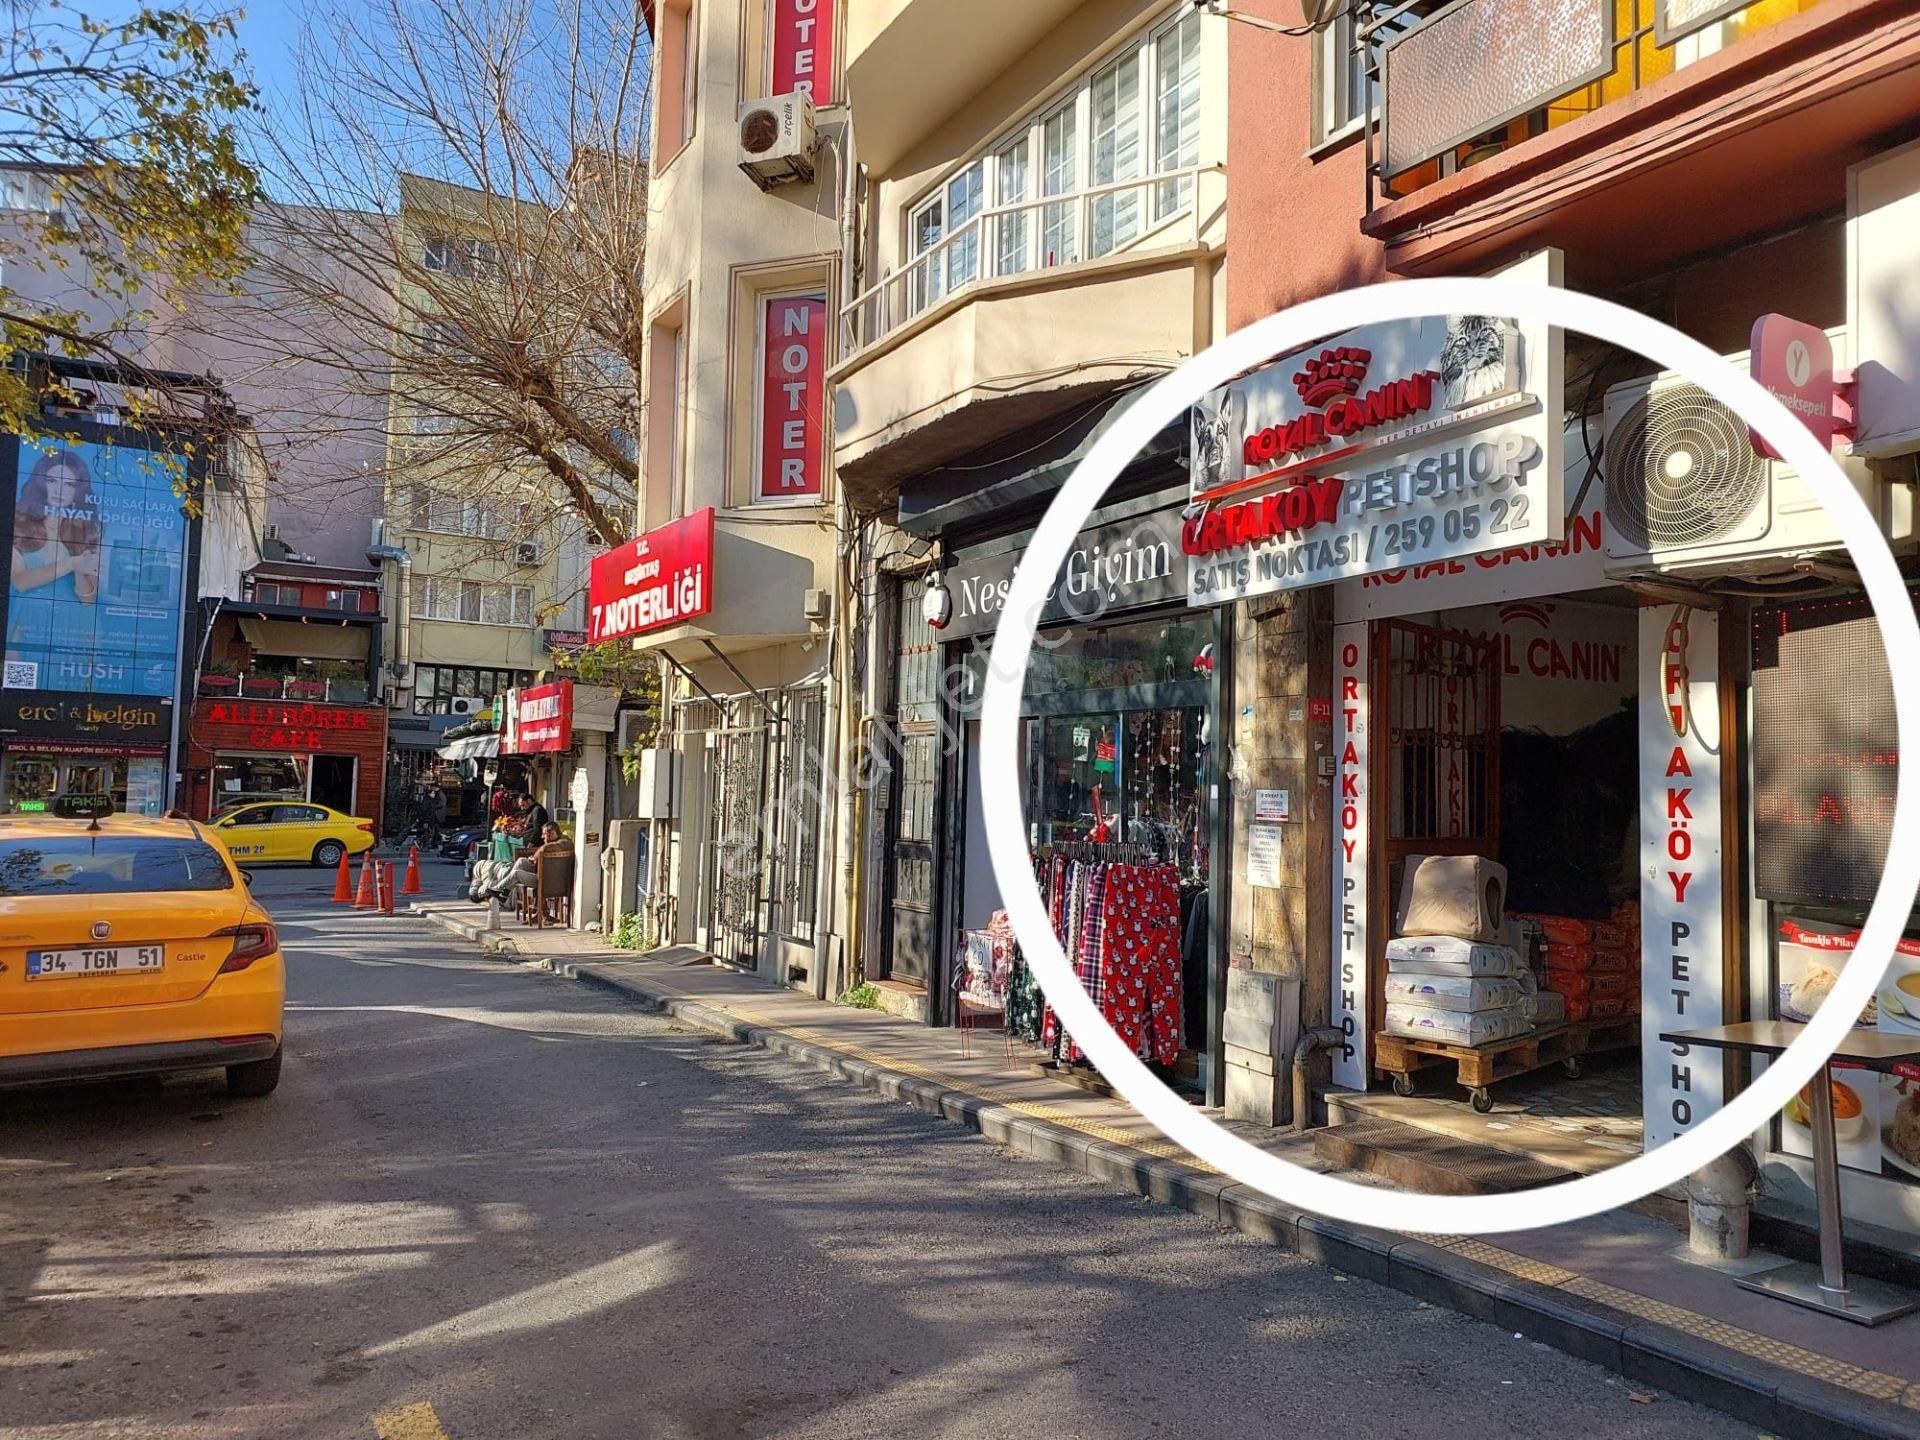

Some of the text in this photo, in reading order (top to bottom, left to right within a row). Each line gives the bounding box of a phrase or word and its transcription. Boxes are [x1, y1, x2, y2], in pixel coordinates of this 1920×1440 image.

[784, 102, 793, 137] arçelik
[781, 306, 809, 487] NOTER
[1244, 372, 1432, 466] ROYAL CANIN
[44, 505, 93, 522] HAYAT
[84, 494, 118, 508] KURU
[1182, 474, 1344, 557] ORTAKÖY
[1066, 537, 1173, 602] Giyim
[1194, 557, 1250, 593] SATIŞ
[1256, 532, 1359, 583] NOKTASI
[1384, 515, 1435, 556] 259
[1443, 504, 1480, 543] 05
[1489, 494, 1529, 534] 22
[592, 563, 702, 639] 7.NOTERLİĞİ
[59, 661, 124, 681] HUSH
[1527, 637, 1621, 683] CANIN
[252, 728, 325, 749] CAFE
[282, 704, 369, 730] BÖREK
[1341, 643, 1359, 1063] ORTAKÖY PET SHOP
[42, 948, 158, 972] 34 TGN 51
[1670, 921, 1691, 1015] PET
